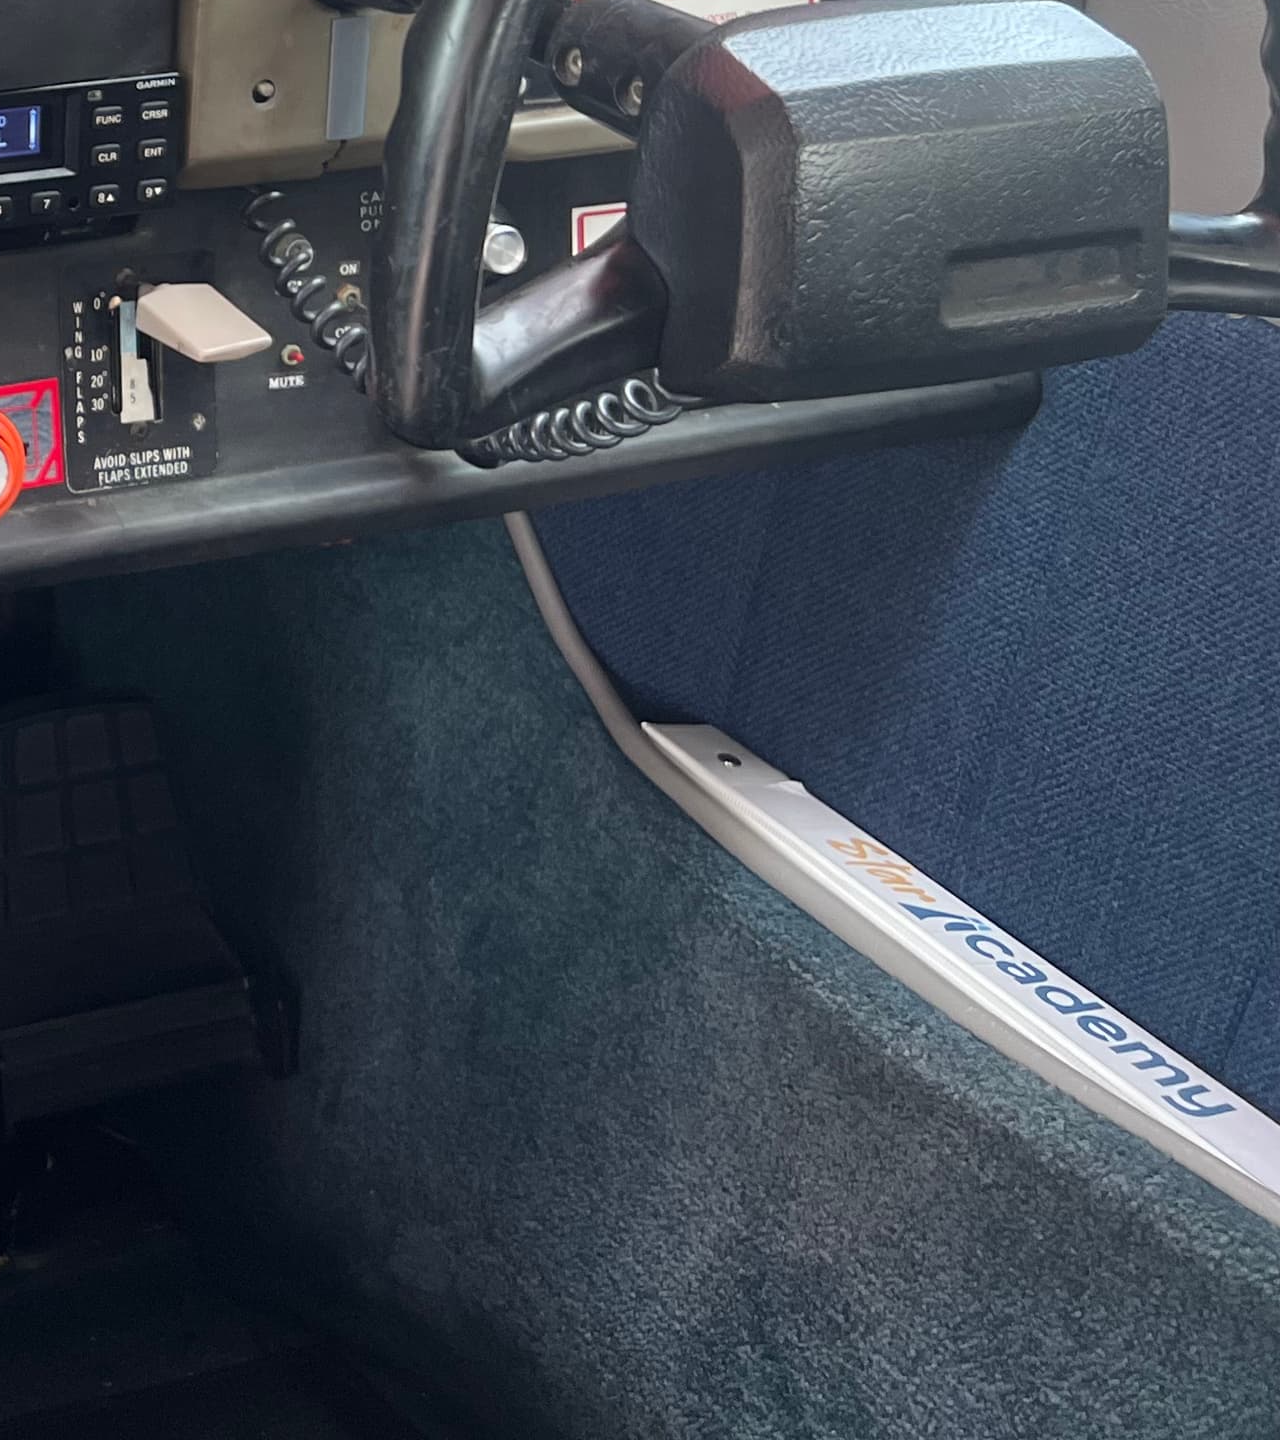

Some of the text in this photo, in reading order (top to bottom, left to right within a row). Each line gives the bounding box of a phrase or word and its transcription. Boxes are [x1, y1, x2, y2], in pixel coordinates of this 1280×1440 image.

[136, 77, 176, 90] GARMIN
[269, 375, 304, 389] MUTE
[94, 446, 190, 469] AVOID SLIPS WITH
[98, 461, 188, 484] FLAPS EXTENDED
[828, 837, 1238, 1118] Star Academy
